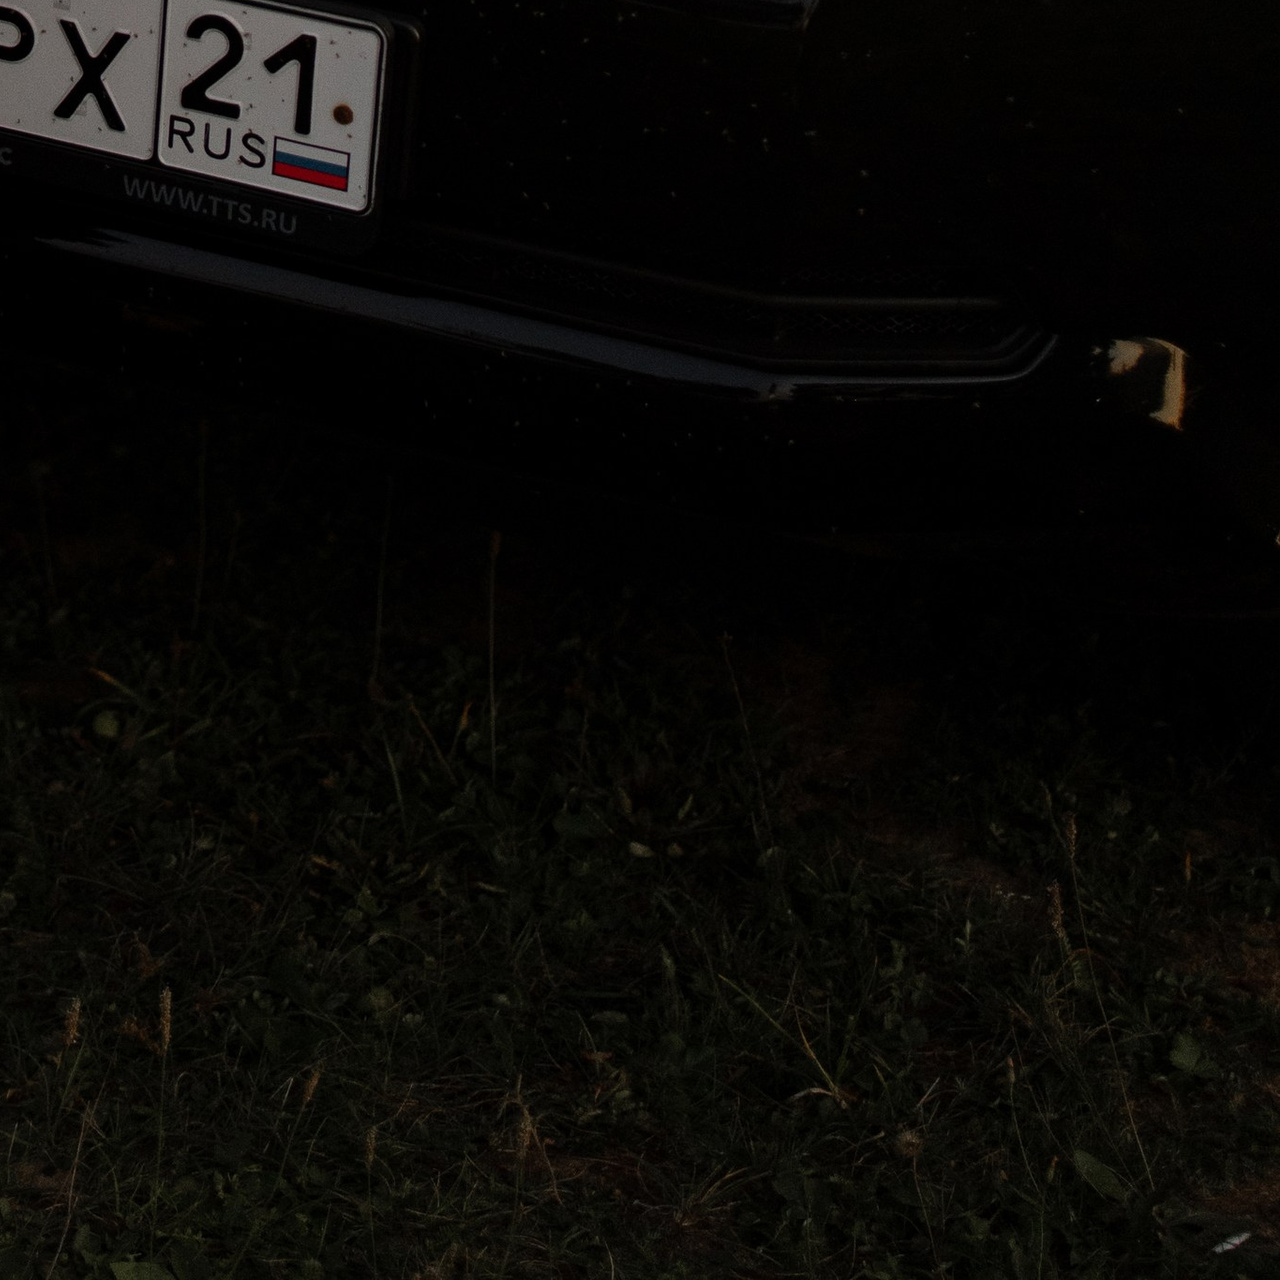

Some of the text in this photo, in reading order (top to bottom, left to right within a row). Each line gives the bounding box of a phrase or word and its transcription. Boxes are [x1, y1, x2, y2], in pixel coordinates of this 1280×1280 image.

[181, 13, 318, 136] 21
[168, 114, 266, 169] RUS
[123, 174, 298, 235] WWW.TTS.RU
